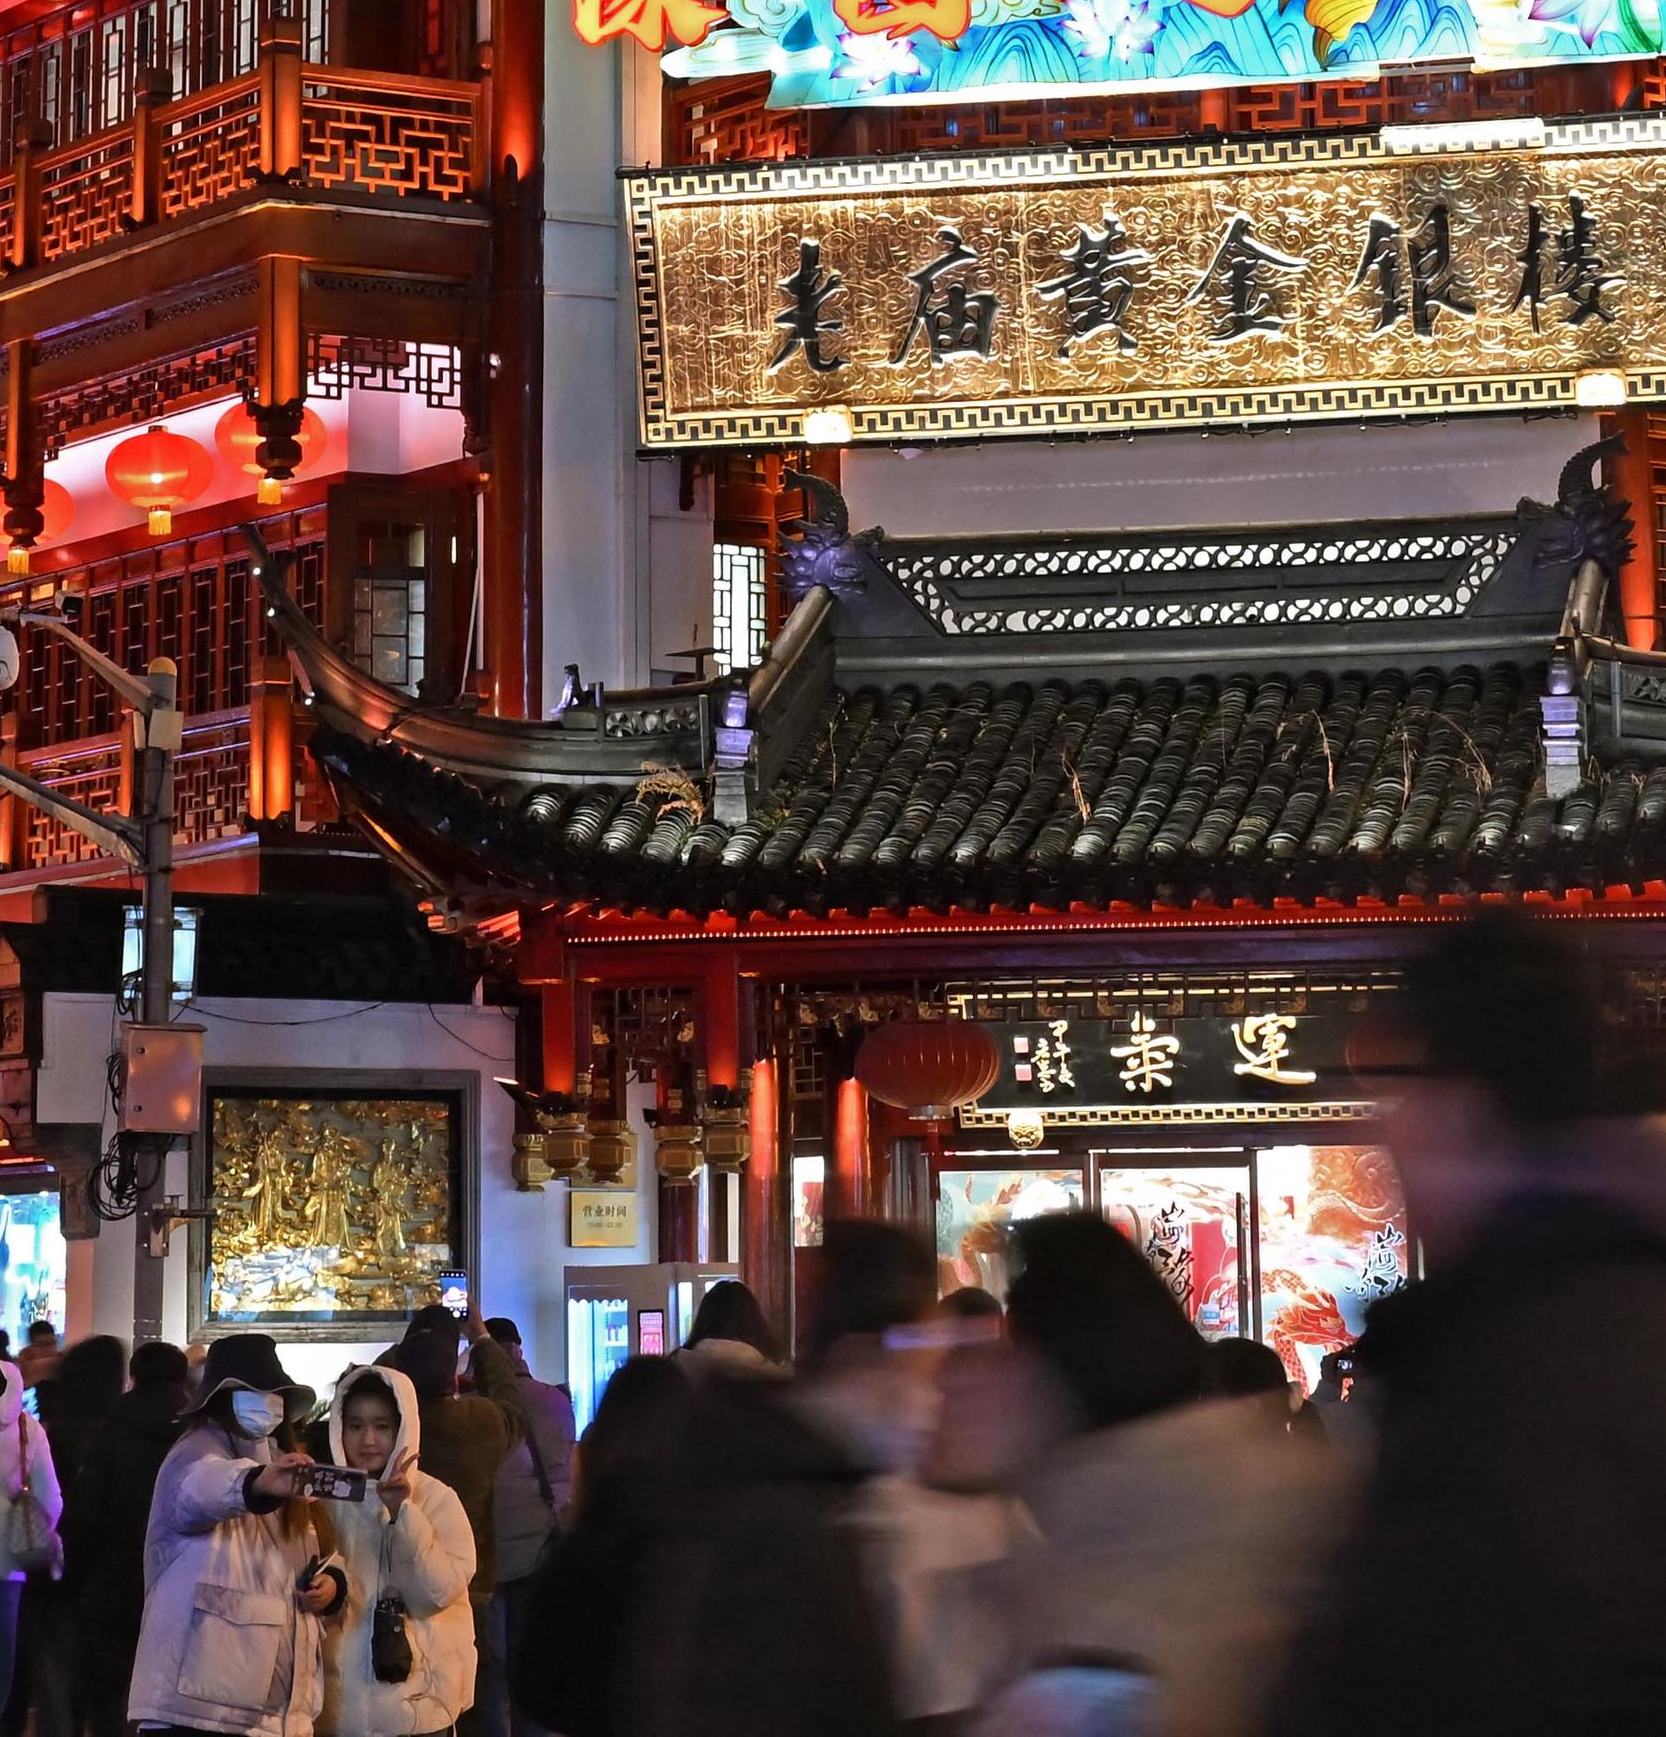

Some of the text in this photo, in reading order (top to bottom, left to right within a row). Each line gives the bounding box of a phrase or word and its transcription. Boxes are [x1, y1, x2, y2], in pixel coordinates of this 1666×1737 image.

[766, 188, 1627, 377] 老庙黄金银楼
